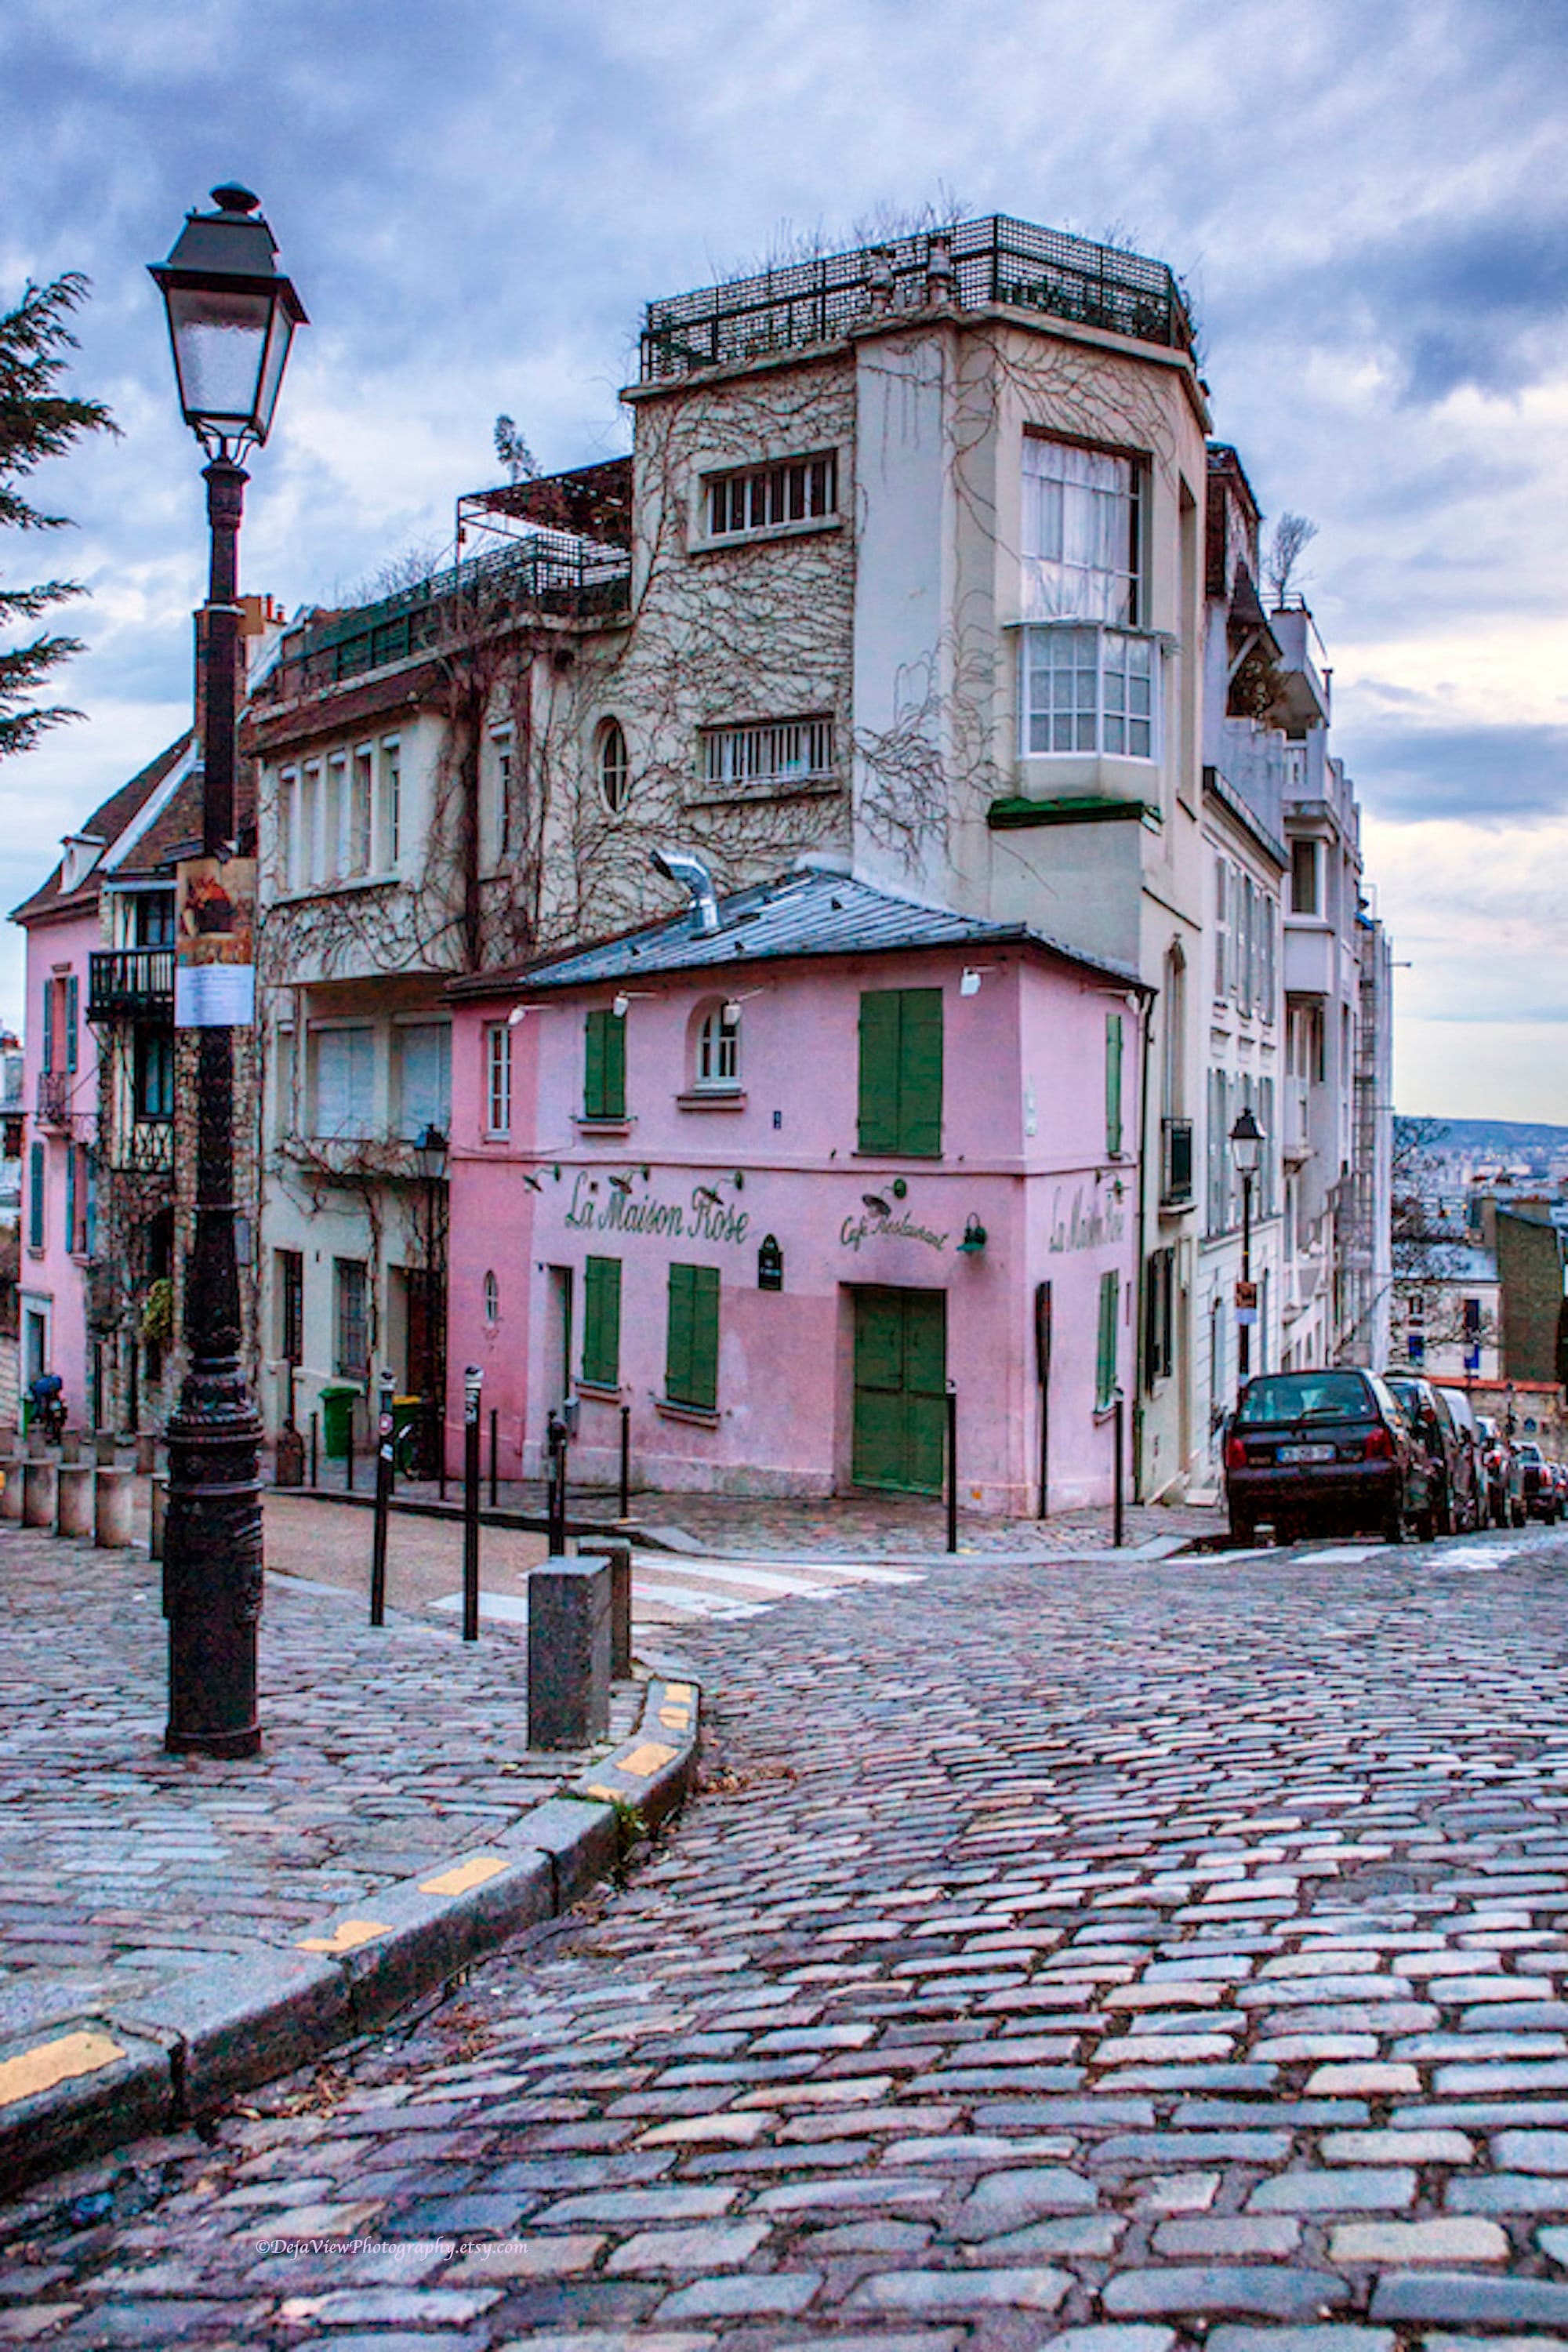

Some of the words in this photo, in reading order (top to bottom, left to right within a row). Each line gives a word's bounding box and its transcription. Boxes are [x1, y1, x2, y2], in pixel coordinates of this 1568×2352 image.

[565, 1171, 597, 1229] La
[598, 1189, 684, 1237] Maison
[687, 1185, 750, 1244] Rose
